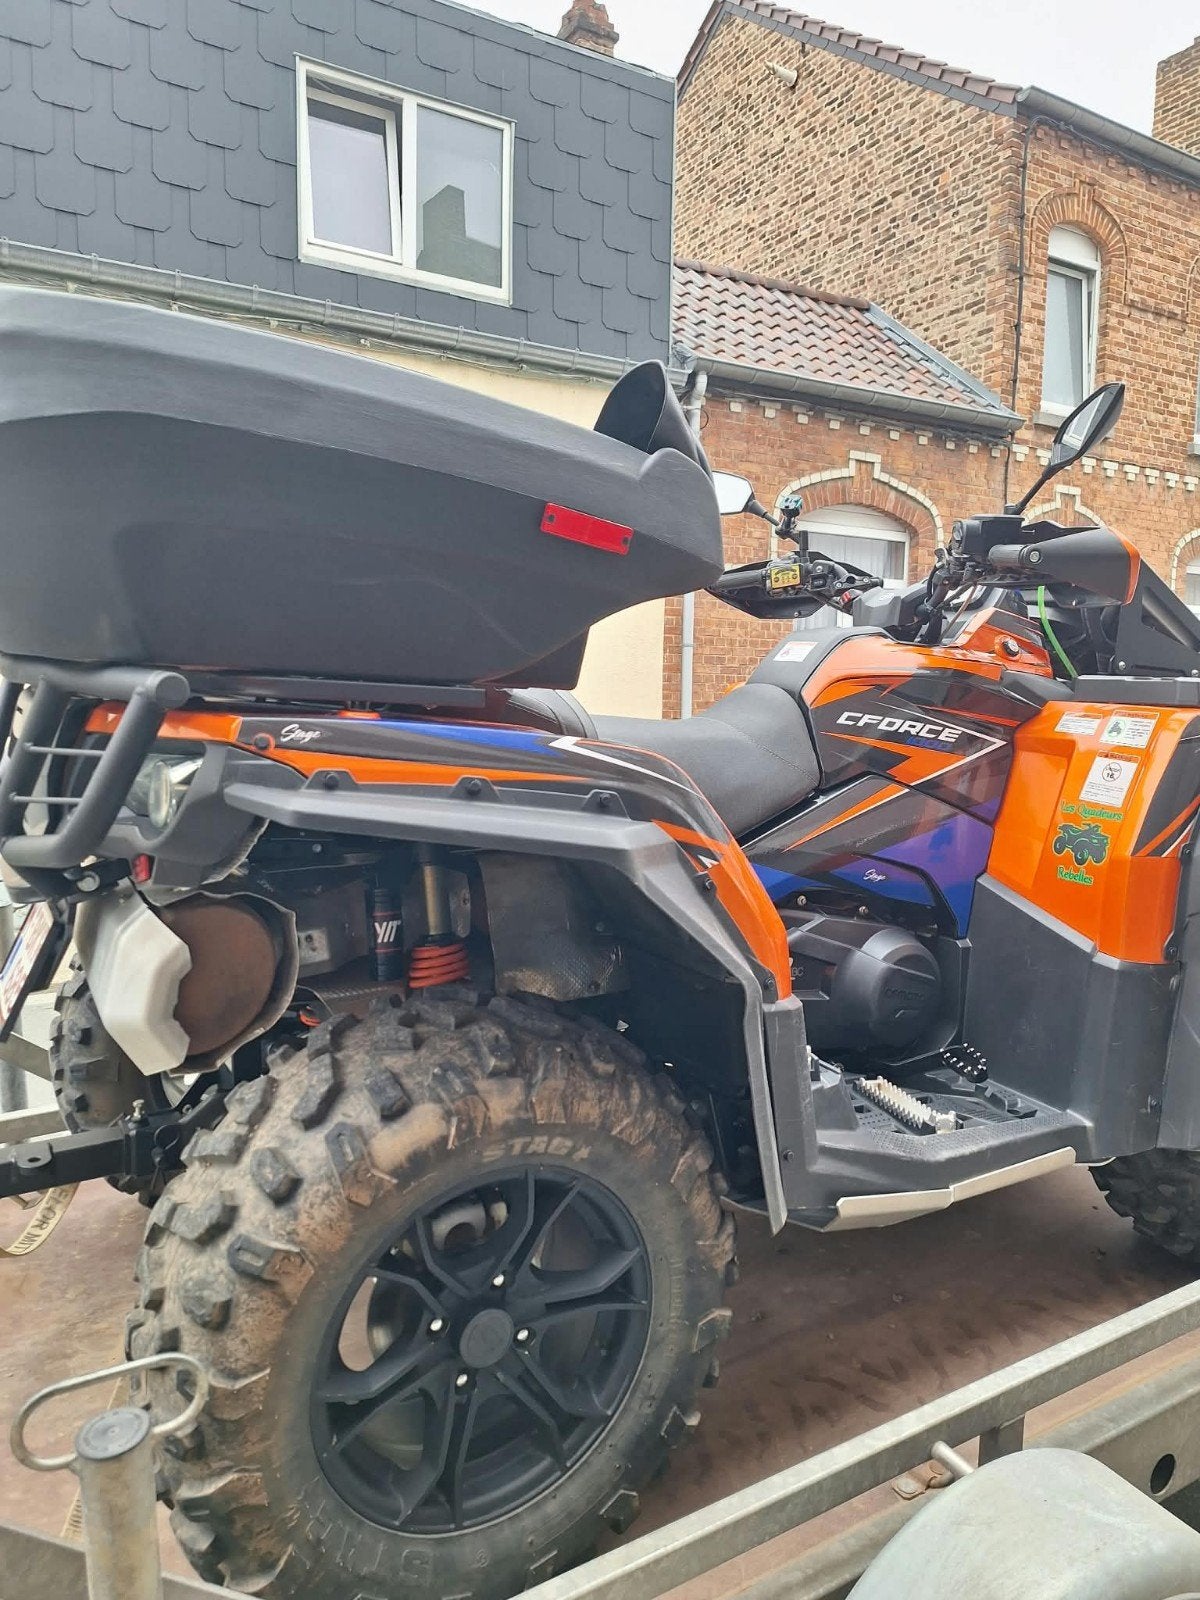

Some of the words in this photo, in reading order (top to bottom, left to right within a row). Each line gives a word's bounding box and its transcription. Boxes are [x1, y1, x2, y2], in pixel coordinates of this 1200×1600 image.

[280, 723, 322, 744] Stage
[836, 711, 962, 743] CFORCE
[1058, 866, 1093, 885] Rebelles
